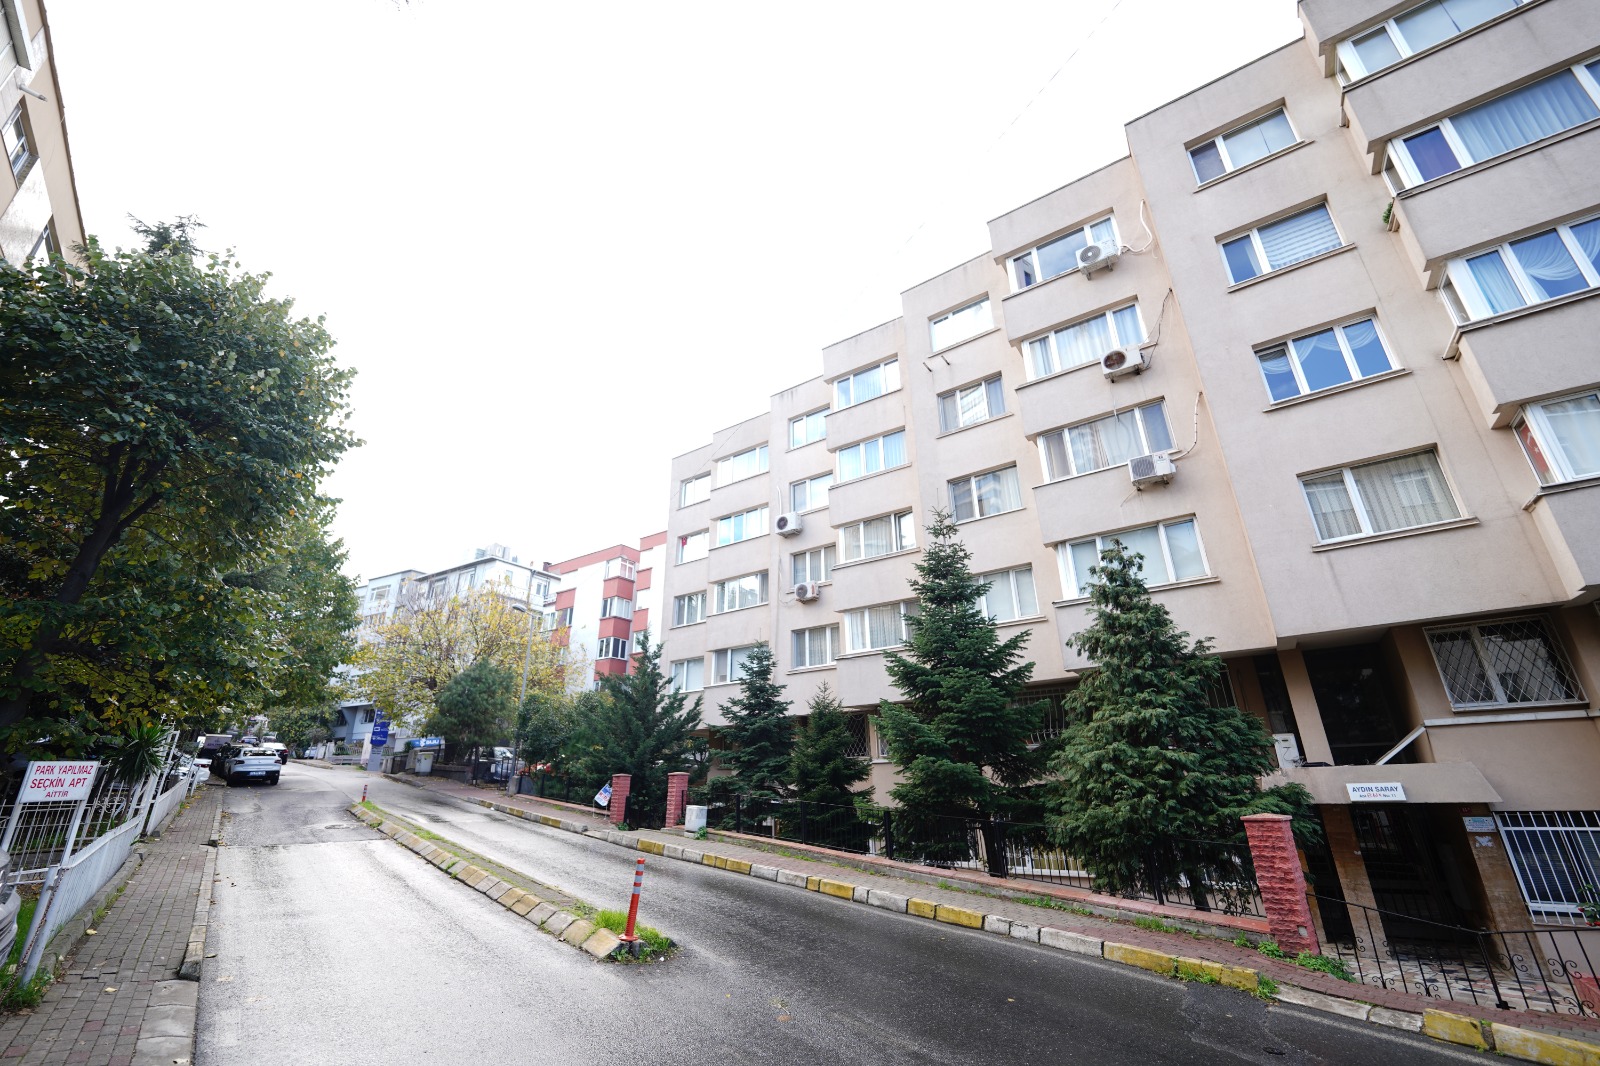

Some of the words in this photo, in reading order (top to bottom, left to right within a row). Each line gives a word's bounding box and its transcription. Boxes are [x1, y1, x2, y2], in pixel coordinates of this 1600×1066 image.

[34, 765, 56, 775] PARK
[57, 765, 94, 775] YAPILMAZ
[30, 777, 65, 791] SEÇKİN
[68, 777, 88, 787] APT
